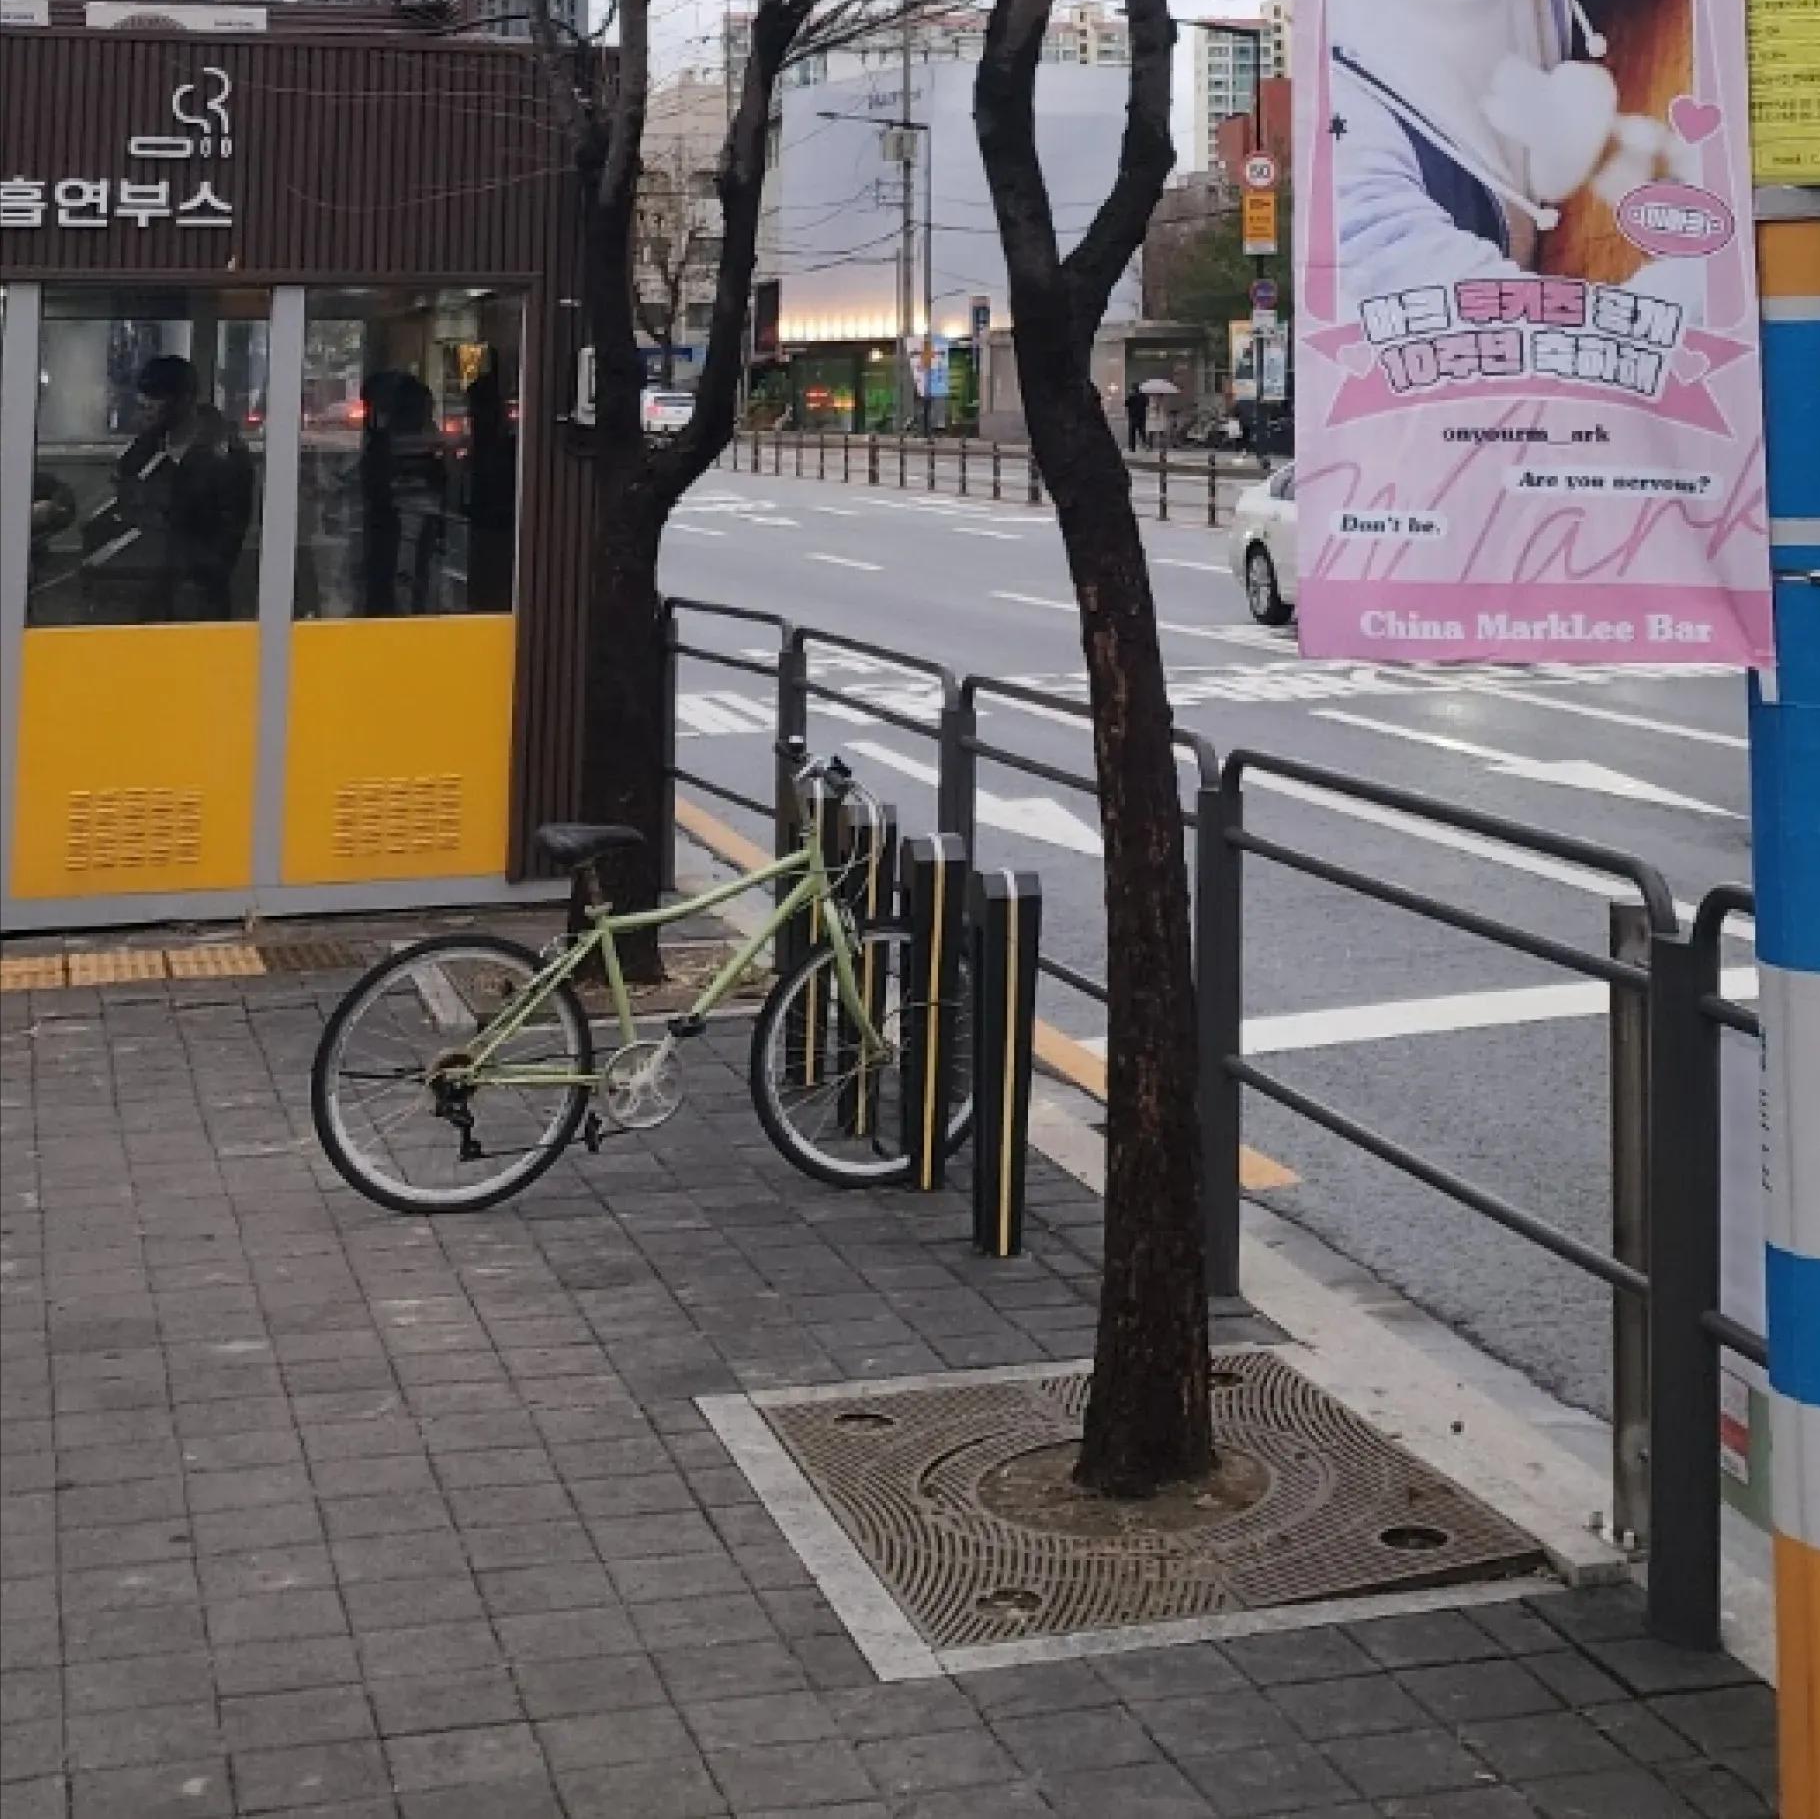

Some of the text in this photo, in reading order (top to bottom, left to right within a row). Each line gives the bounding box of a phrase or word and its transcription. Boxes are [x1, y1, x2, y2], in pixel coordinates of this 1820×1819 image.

[0, 175, 233, 228] 흡연부스
[1454, 278, 1587, 327] 루키즈
[1382, 329, 1524, 394] 10주년
[1519, 470, 1712, 495] Are you nervous?
[1339, 512, 1402, 534] Don't
[1360, 609, 1714, 644] China MarkLee Bar
